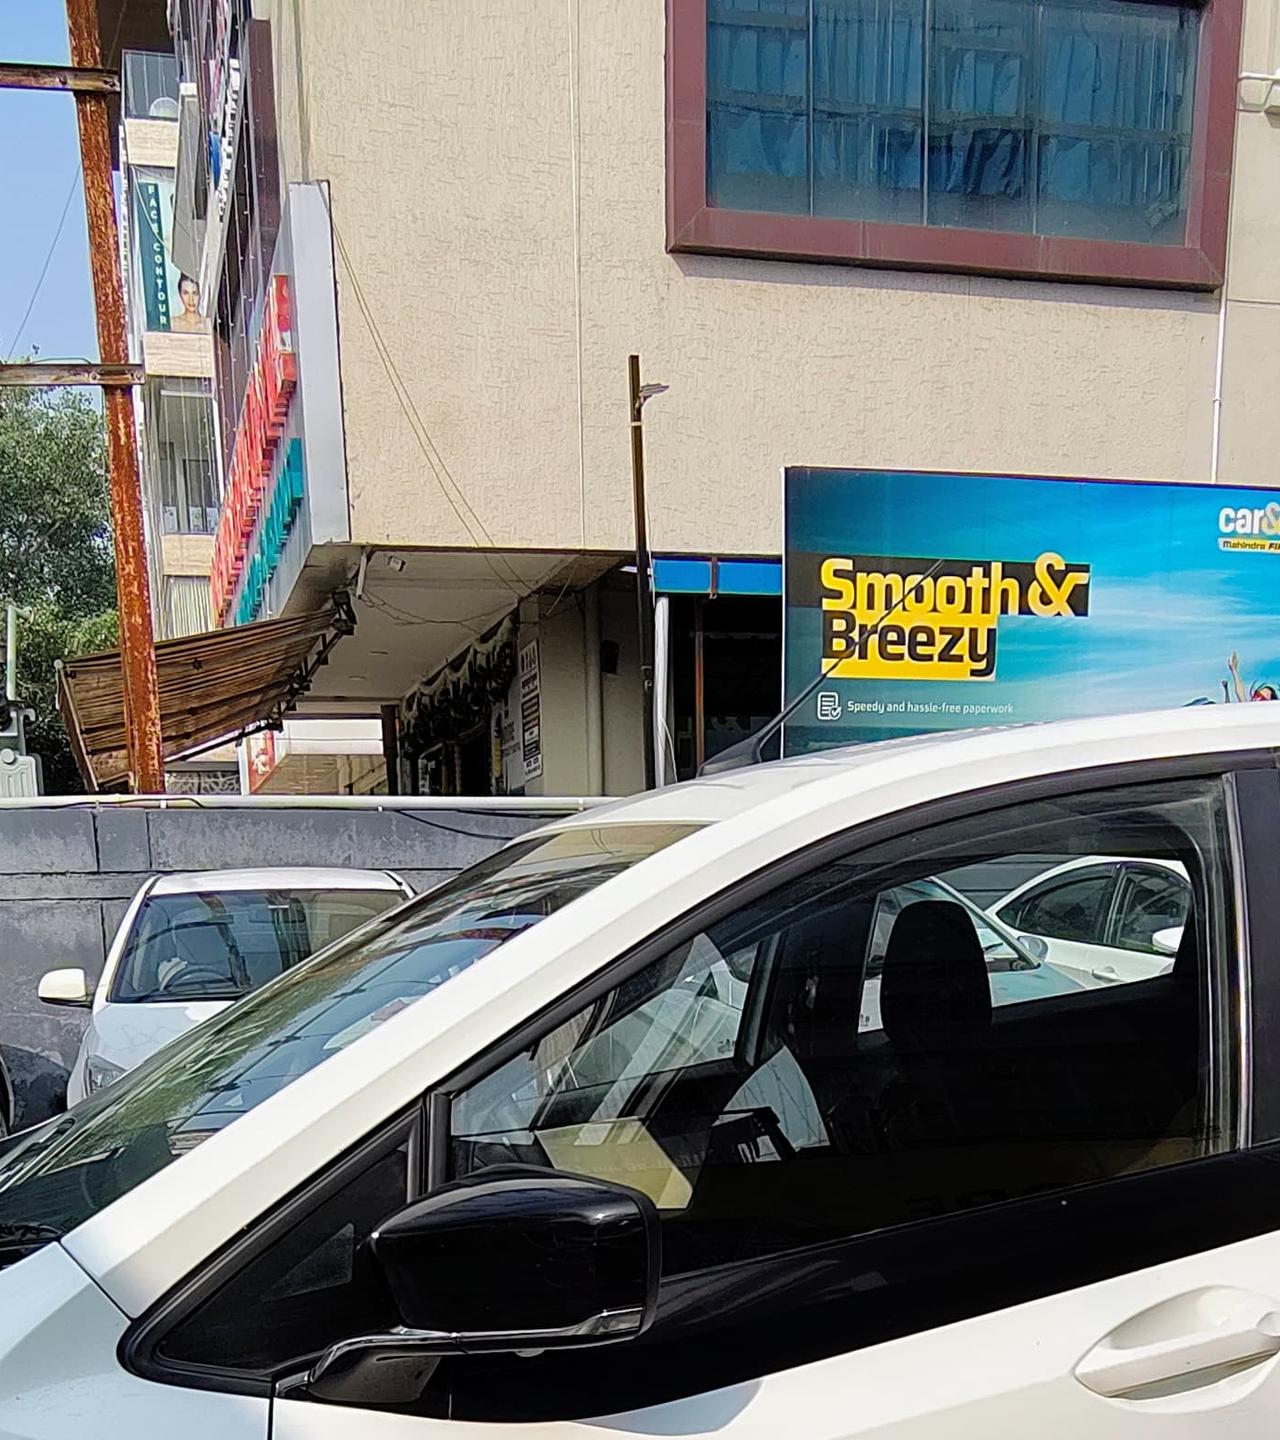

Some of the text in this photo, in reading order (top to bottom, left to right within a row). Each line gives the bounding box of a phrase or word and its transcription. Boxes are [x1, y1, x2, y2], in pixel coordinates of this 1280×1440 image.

[153, 242, 167, 325] CONTOUR
[820, 552, 1089, 616] Smooth &
[822, 610, 997, 677] Breezy
[847, 701, 1014, 716] Speedy and hassle-free paperwork
